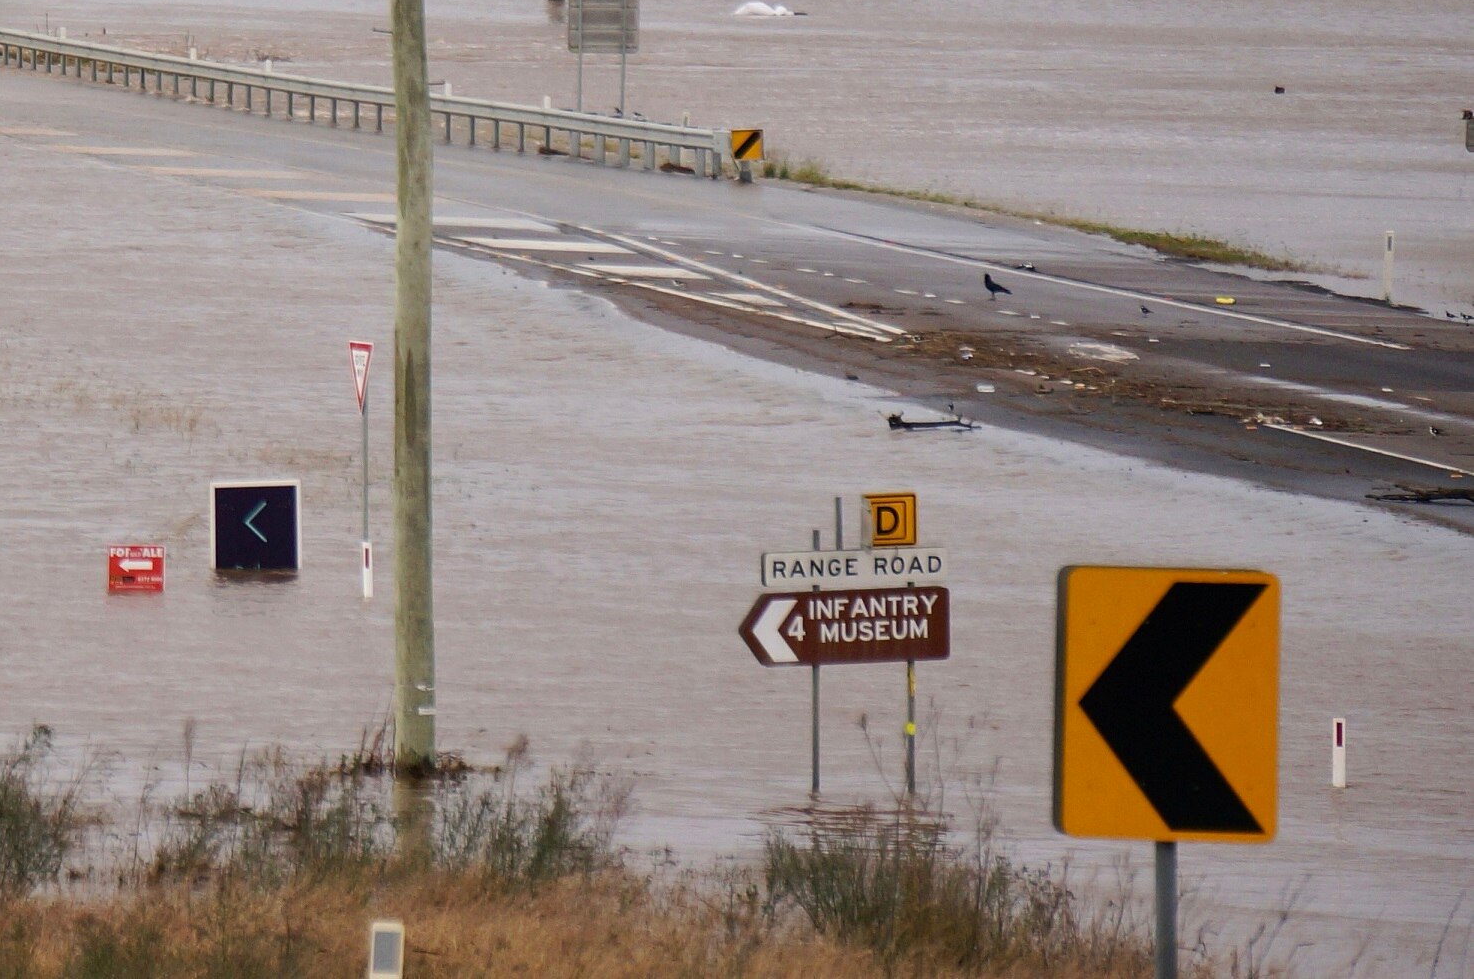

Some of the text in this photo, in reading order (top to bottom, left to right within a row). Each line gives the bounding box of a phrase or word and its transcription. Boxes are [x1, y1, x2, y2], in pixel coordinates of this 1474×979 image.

[876, 506, 900, 535] D
[139, 547, 163, 558] ALE
[773, 556, 942, 578] RANGE ROAD
[808, 594, 939, 620] INFANTRY
[787, 616, 806, 641] 4
[820, 619, 929, 643] MUSEUM
